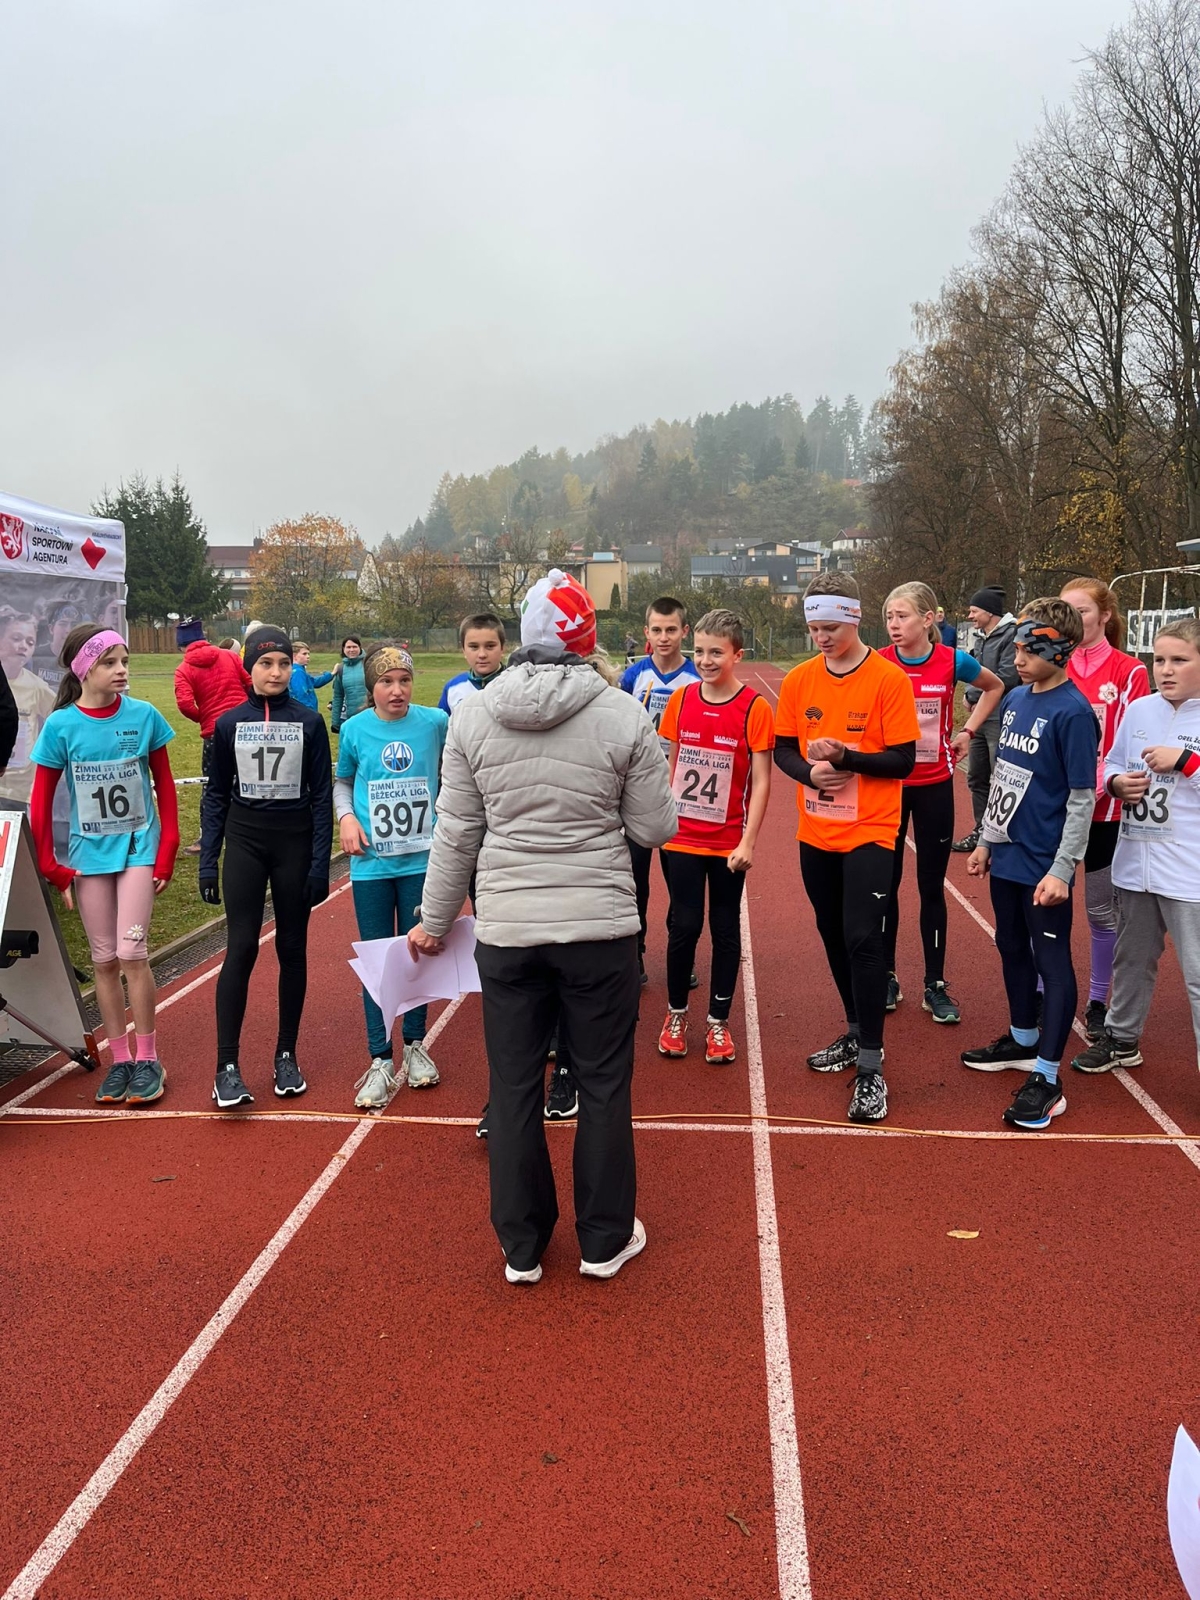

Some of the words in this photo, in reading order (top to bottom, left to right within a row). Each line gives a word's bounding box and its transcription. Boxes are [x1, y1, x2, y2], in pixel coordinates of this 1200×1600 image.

[32, 537, 74, 551] SPORTOVNÍ
[33, 551, 68, 565] AGENTURA
[1002, 709, 1017, 726] 66
[238, 724, 264, 733] ZIMNÍ
[237, 732, 276, 742] BĚŽECKÁ
[280, 734, 300, 742] LIGA
[1006, 732, 1040, 754] JAKO
[1177, 734, 1193, 742] OREL
[680, 747, 701, 757] ZIMNÍ
[74, 764, 102, 773] ZIMNÍ
[251, 746, 286, 781] 17
[679, 755, 710, 767] BĚŽECKÁ
[713, 761, 730, 770] LIGA
[75, 771, 115, 782] BĚŽECKÁ
[119, 768, 138, 779] LIGA
[1156, 774, 1175, 784] LIGA
[370, 780, 395, 791] ZIMNÍ
[680, 769, 718, 804] 24
[1009, 777, 1025, 790] LIGA
[370, 788, 407, 800] BĚŽECKÁ
[410, 787, 429, 797] LIGA
[91, 784, 130, 819] 16
[374, 800, 429, 839] 397
